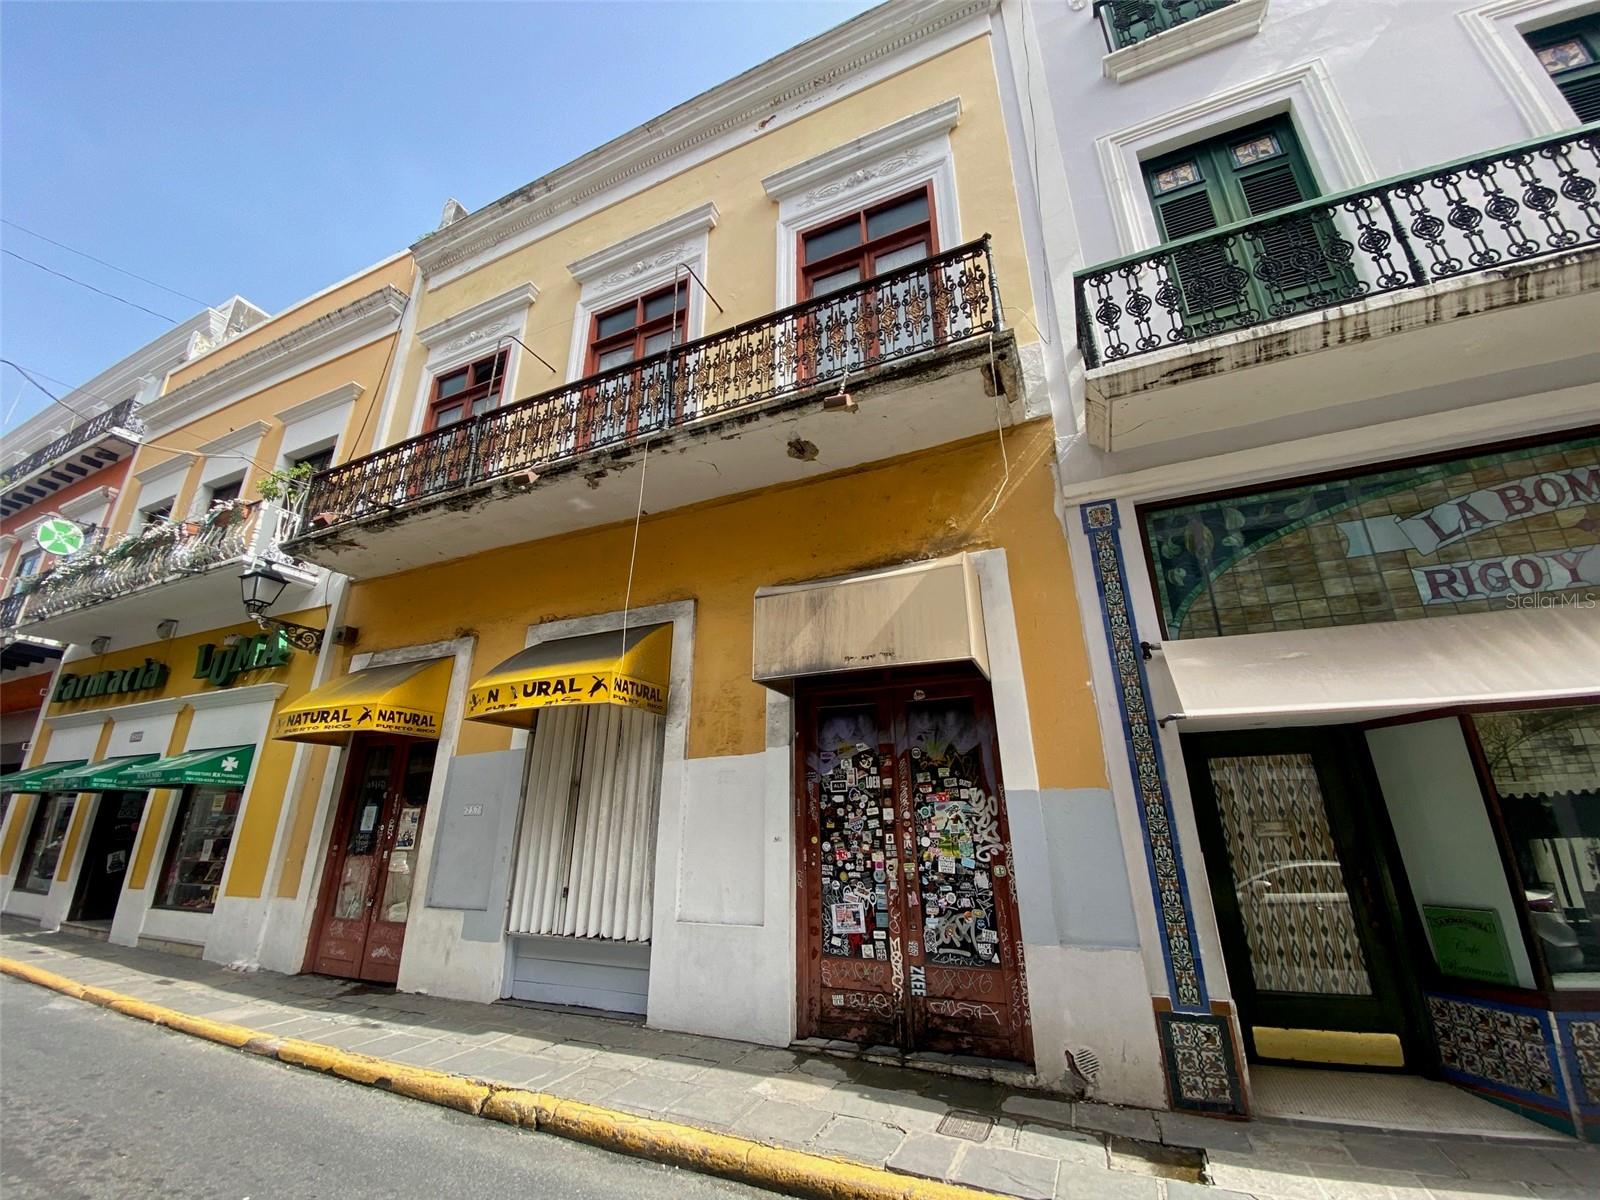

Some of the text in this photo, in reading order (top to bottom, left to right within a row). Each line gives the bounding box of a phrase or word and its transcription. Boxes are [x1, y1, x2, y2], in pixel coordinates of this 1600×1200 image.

[1421, 469, 1600, 543] LA BOM
[614, 678, 663, 703] NATURAL
[287, 709, 352, 728] NATURAL
[324, 723, 351, 731] RICO
[377, 709, 437, 728] NATURAL
[375, 724, 413, 733] PUERTO
